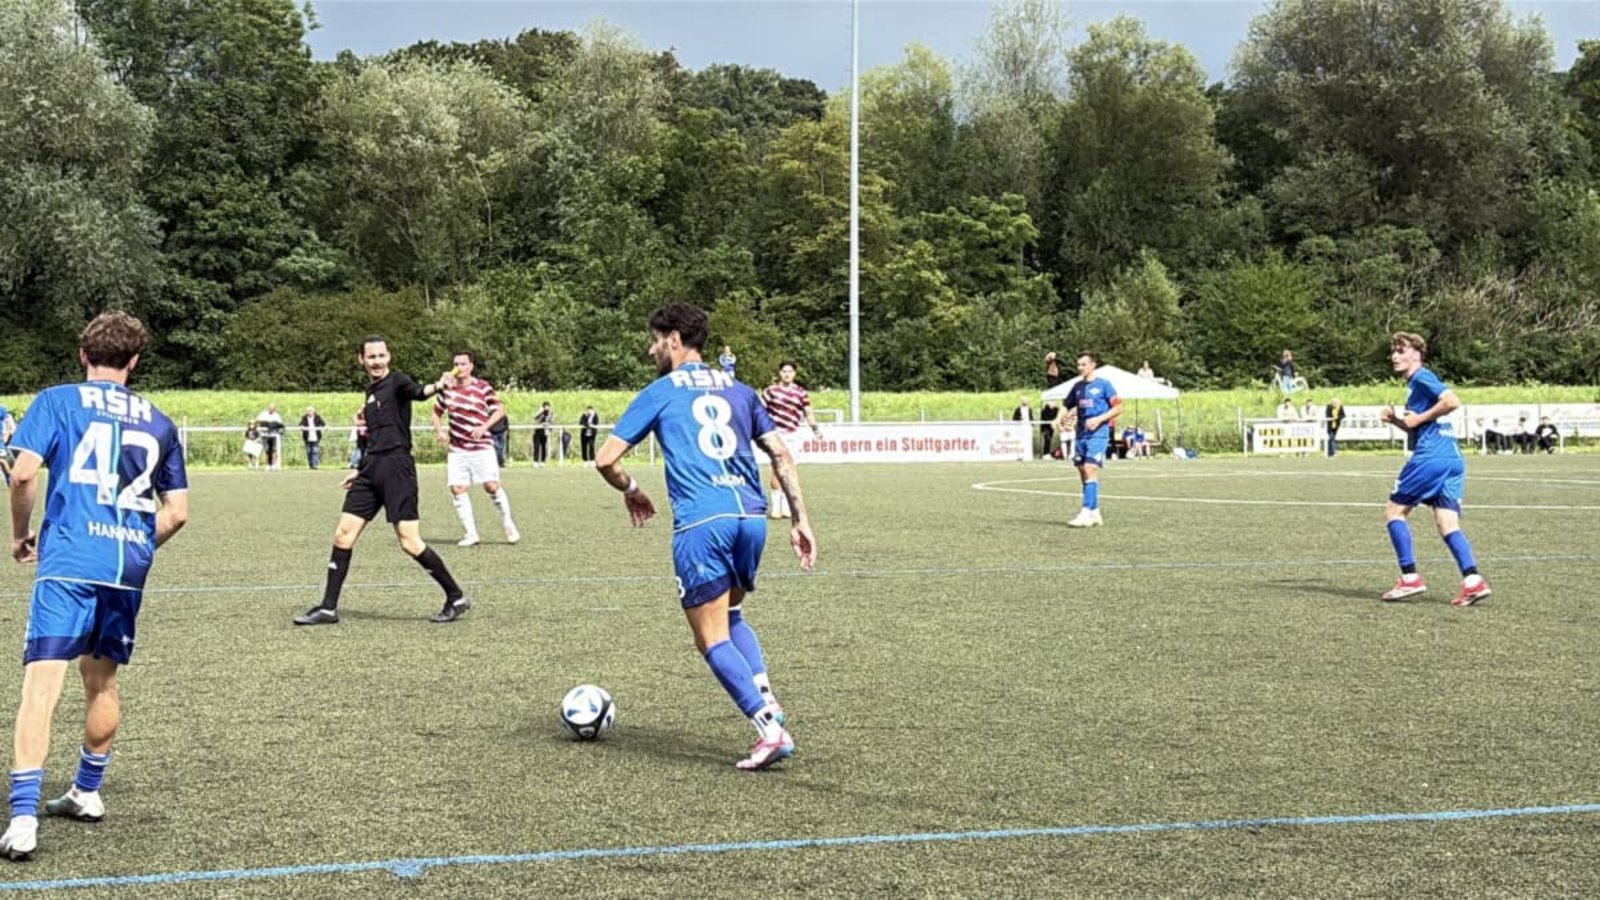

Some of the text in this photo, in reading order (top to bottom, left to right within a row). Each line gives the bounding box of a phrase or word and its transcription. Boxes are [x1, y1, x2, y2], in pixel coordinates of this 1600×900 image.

[691, 395, 738, 461] 8
[799, 437, 837, 453] eben
[841, 441, 872, 455] gern
[875, 438, 898, 452] ein
[901, 437, 980, 454] Stuttgarter.
[69, 421, 160, 513] 42
